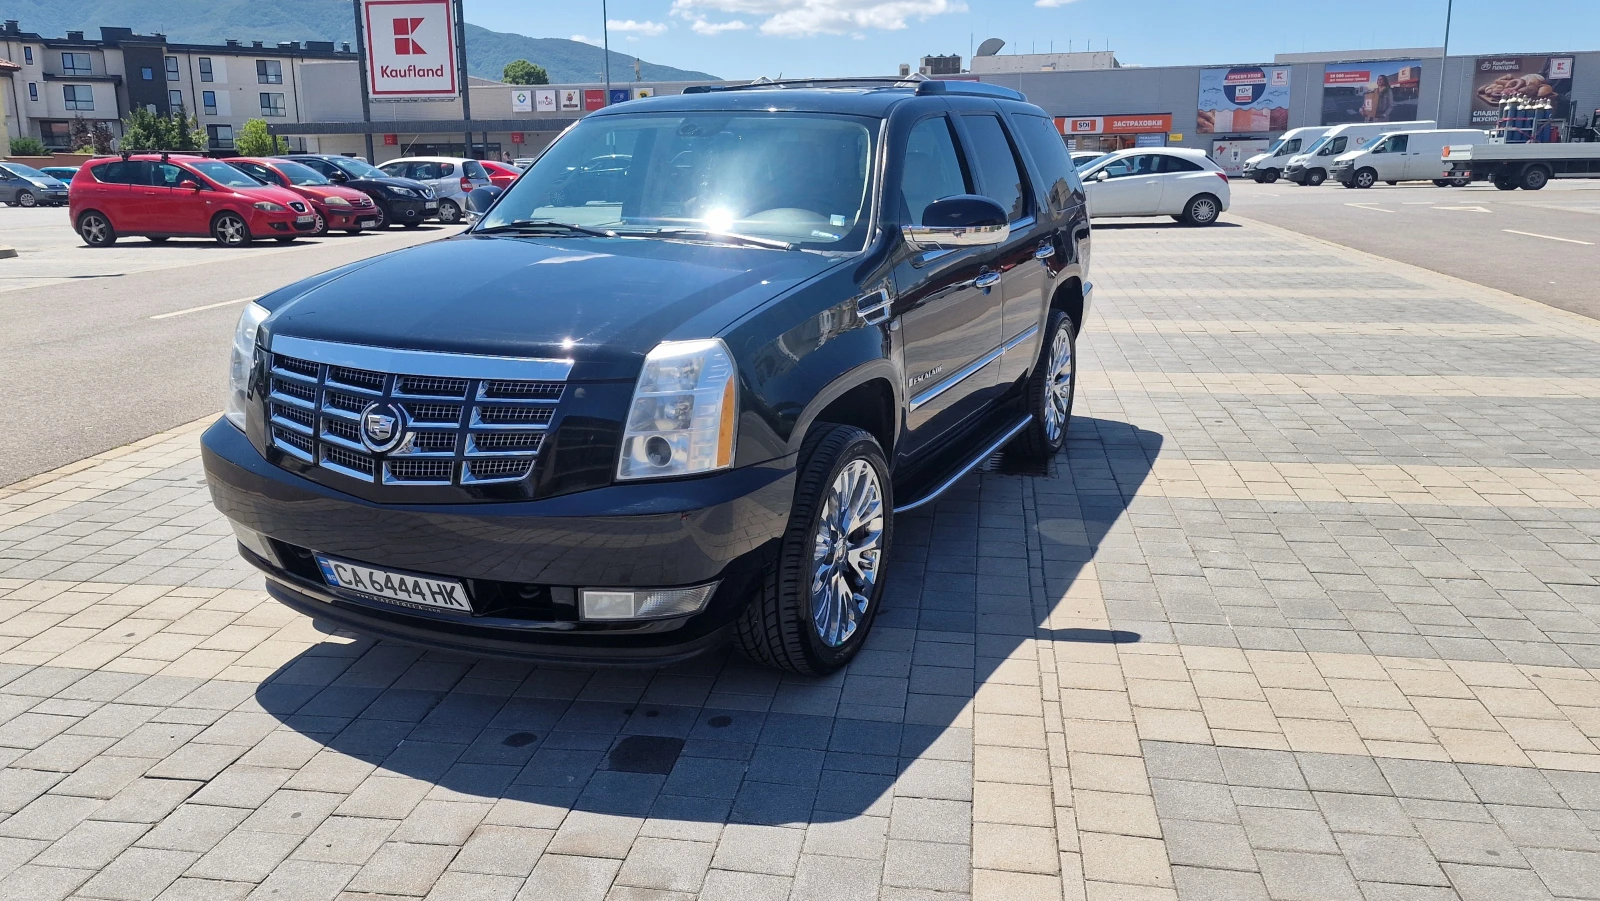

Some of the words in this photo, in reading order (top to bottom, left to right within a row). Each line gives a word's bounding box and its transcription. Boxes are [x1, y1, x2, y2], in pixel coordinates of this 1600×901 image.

[380, 64, 444, 78] Kaufland
[1078, 121, 1090, 129] SDI
[368, 571, 427, 602] 6444
